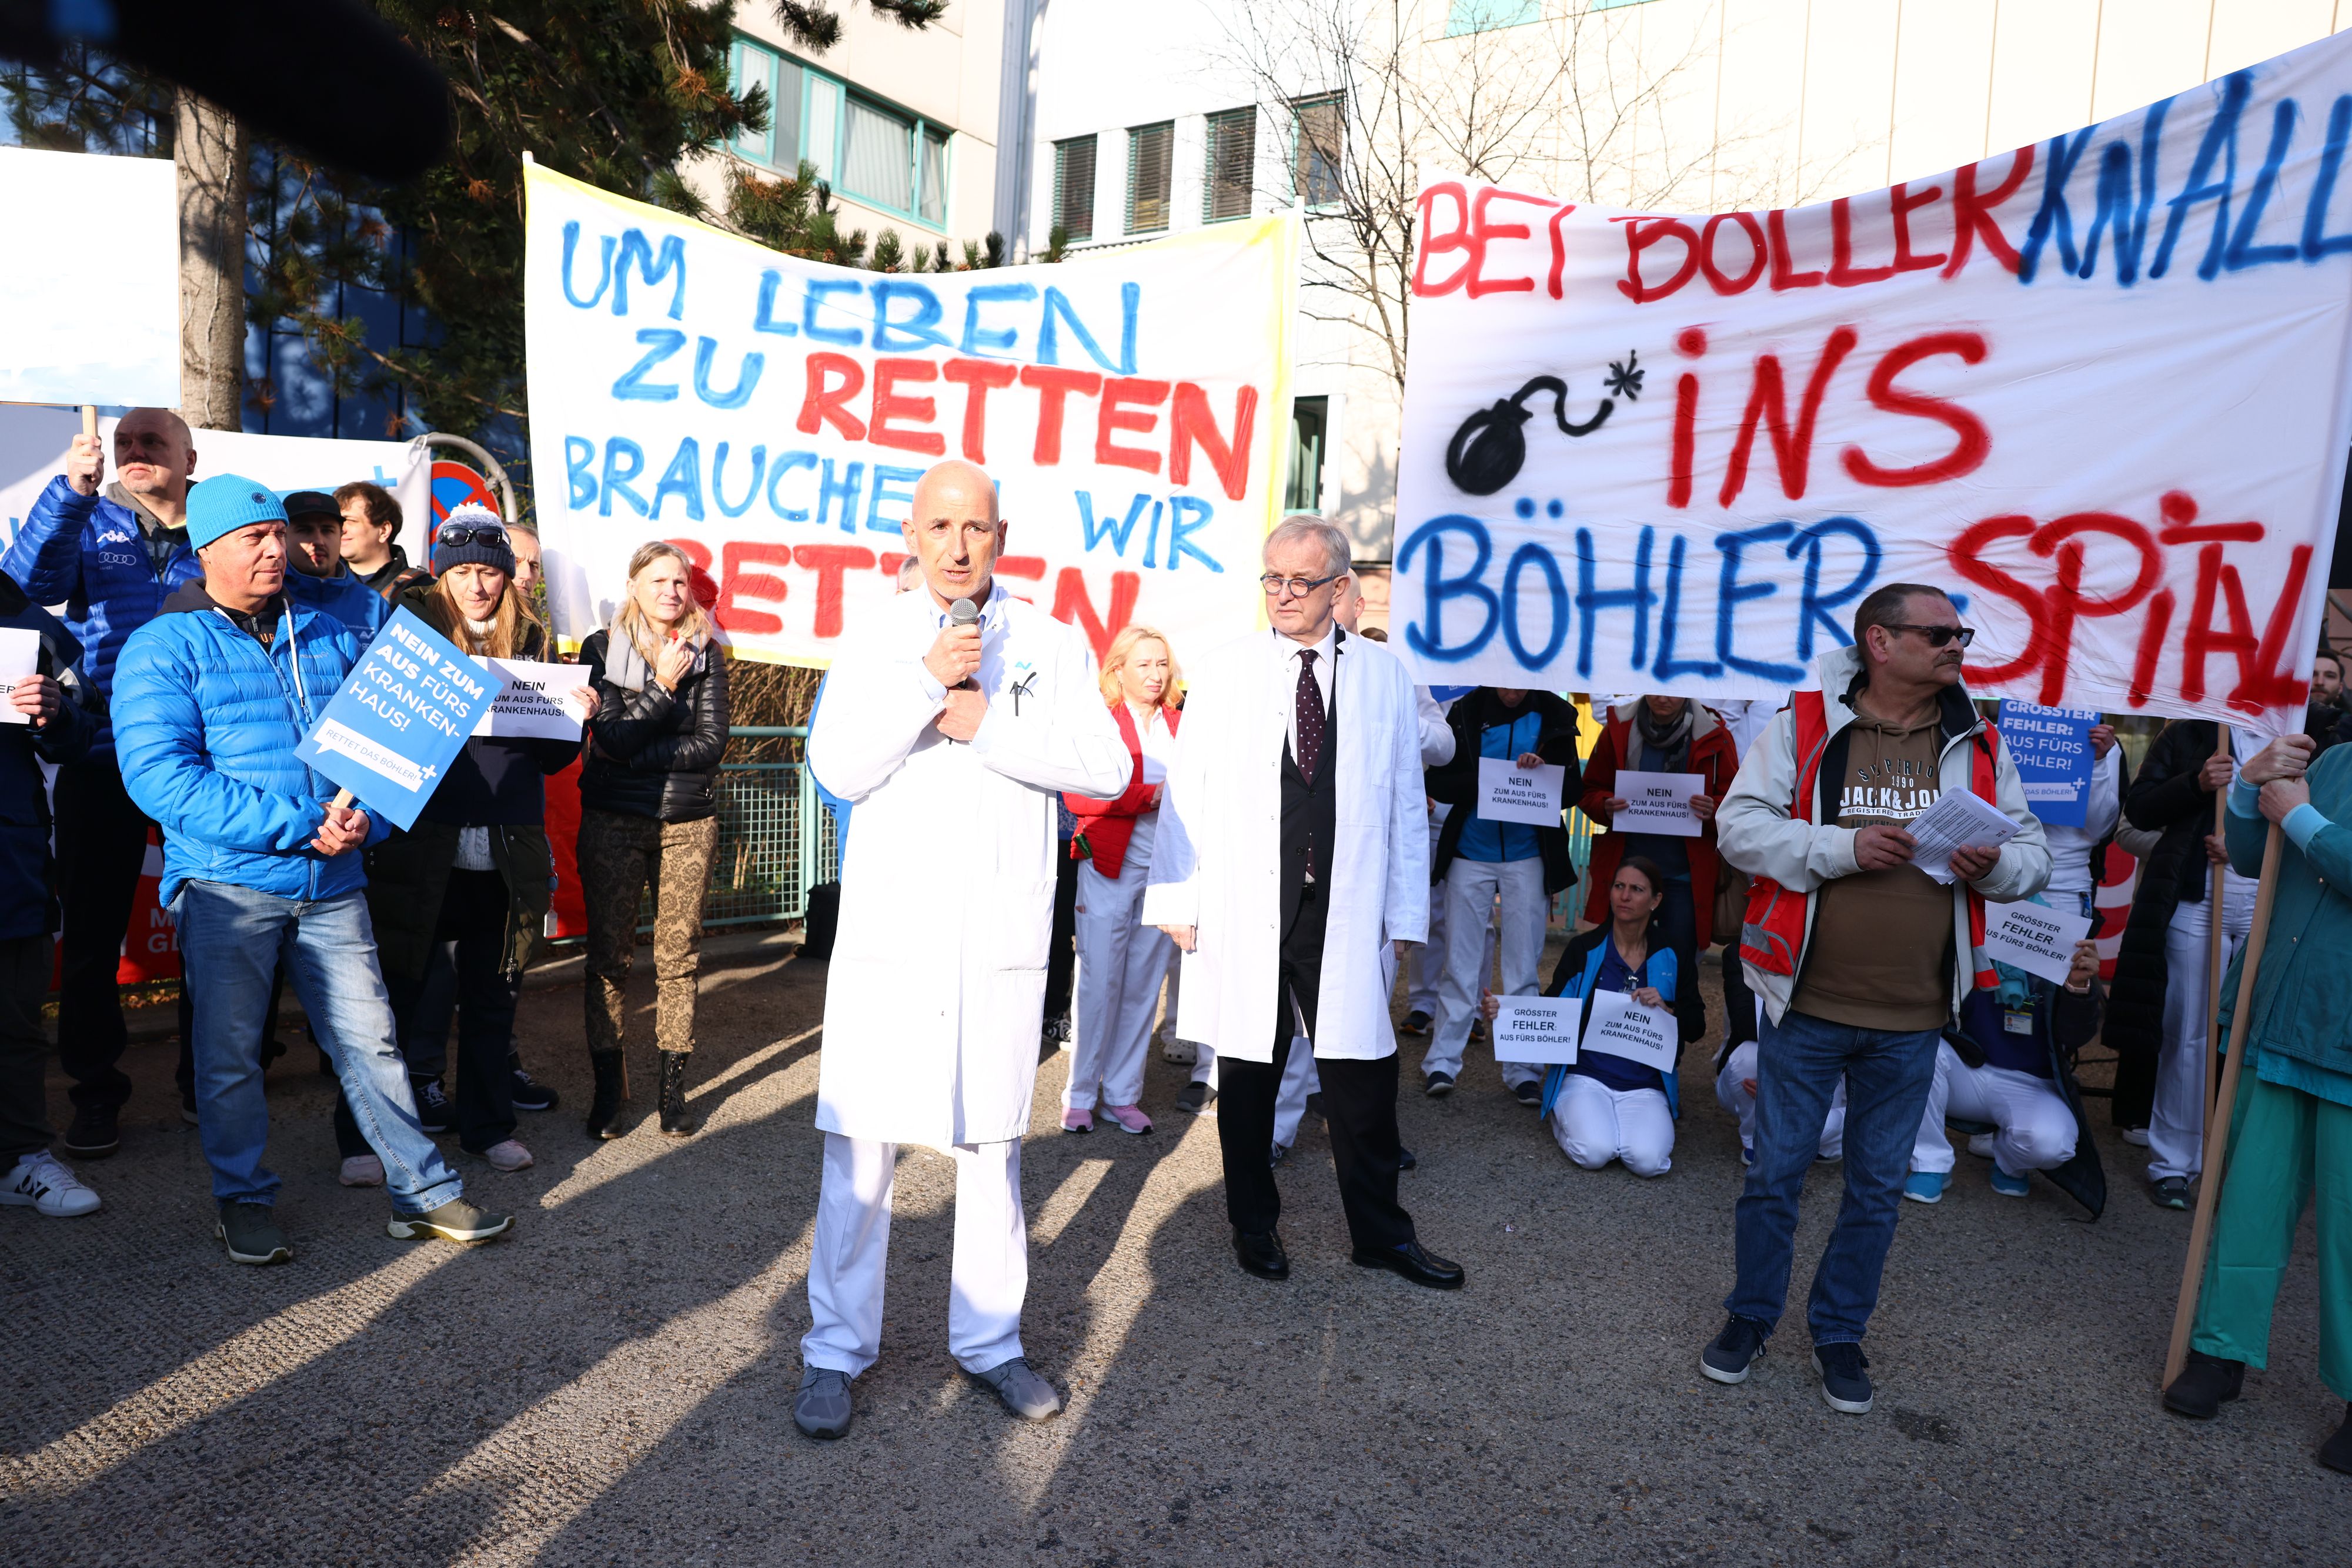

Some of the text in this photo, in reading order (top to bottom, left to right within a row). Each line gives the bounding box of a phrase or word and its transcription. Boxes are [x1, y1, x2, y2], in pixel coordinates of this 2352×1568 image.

[1410, 180, 1577, 300] BEI
[562, 220, 1141, 376] UM LEBEN
[611, 327, 1258, 502] ZU RETTEN
[564, 434, 1000, 536] BRAUCHE
[1074, 490, 1224, 573] WIR
[663, 537, 1141, 672] BETN
[389, 622, 485, 701] NEIN ZUM
[375, 644, 471, 718] AUS FÜRS
[511, 680, 546, 691] NEIN
[348, 680, 412, 732] HAUS!
[362, 661, 460, 737] KRANKEN-
[512, 696, 534, 704] AUS
[536, 695, 564, 705] FÜRS
[2003, 717, 2074, 736] FEHLER:
[2003, 734, 2083, 754] AUS FÜRS
[326, 729, 418, 781] RETTET DAS BÖHLER!
[2011, 750, 2072, 770] ÖHLER!
[1508, 777, 1532, 787] NEIN
[1892, 775, 1914, 788] 1990
[1492, 796, 1548, 808] KRANKENHAUS!
[1528, 791, 1546, 800] FÜRS
[1646, 788, 1672, 797] NEIN
[1628, 808, 1689, 818] KRANKENHAUS!
[1667, 801, 1688, 809] FÜRS
[1847, 807, 1926, 818] REGISTERED TRAD
[2010, 912, 2061, 933] GRÖSSTER
[2002, 921, 2056, 946] FEHLER:
[1986, 928, 2067, 962] US FÜRS BÖHLER!
[1514, 1008, 1558, 1017] GRÖSSTER
[1623, 1011, 1651, 1025] NEIN
[1512, 1020, 1557, 1031] FEHLER:
[1605, 1021, 1663, 1041] ZUM AUS FÜRS
[1516, 1034, 1535, 1042] FÜRS
[1537, 1034, 1571, 1043] BÖHLER!
[1600, 1029, 1663, 1051] KRANKENHAUS!
